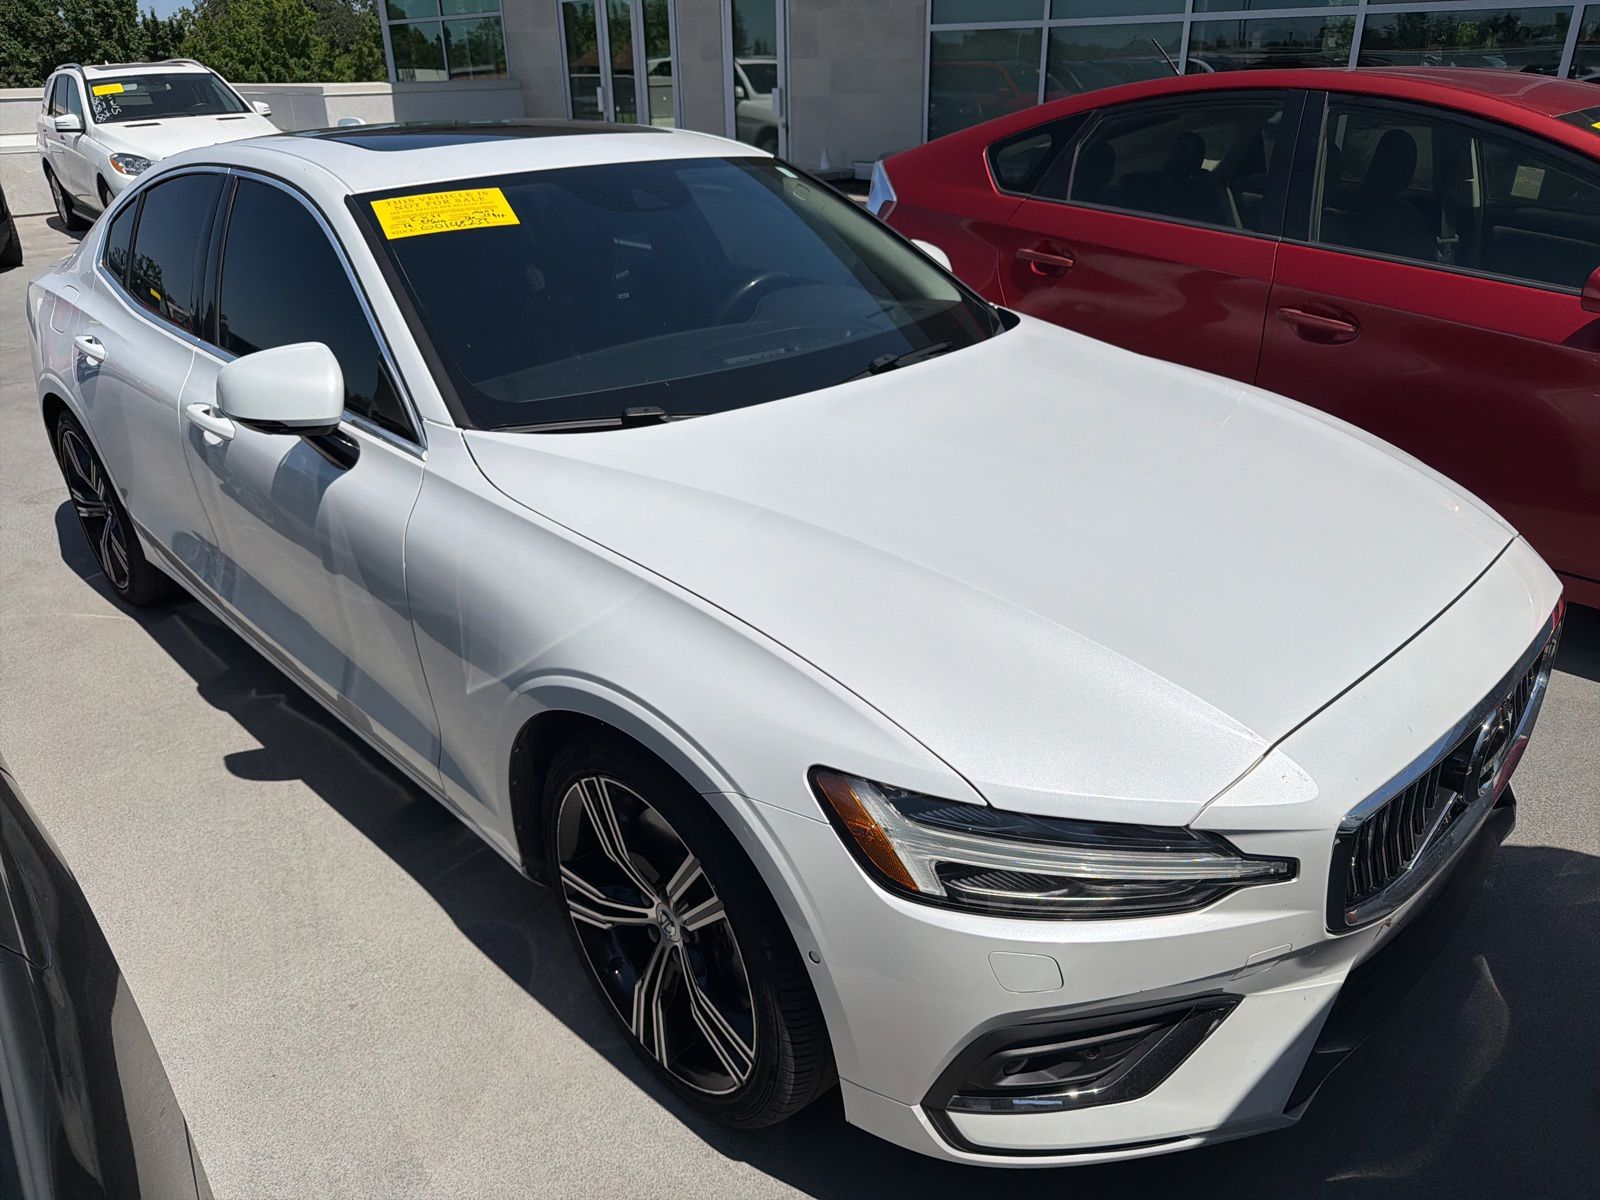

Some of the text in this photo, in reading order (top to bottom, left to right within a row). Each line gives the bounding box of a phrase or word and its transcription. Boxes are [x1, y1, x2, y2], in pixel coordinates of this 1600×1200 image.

[386, 198, 415, 206] THIS
[418, 191, 474, 202] VEHICLE
[454, 195, 486, 203] SALE
